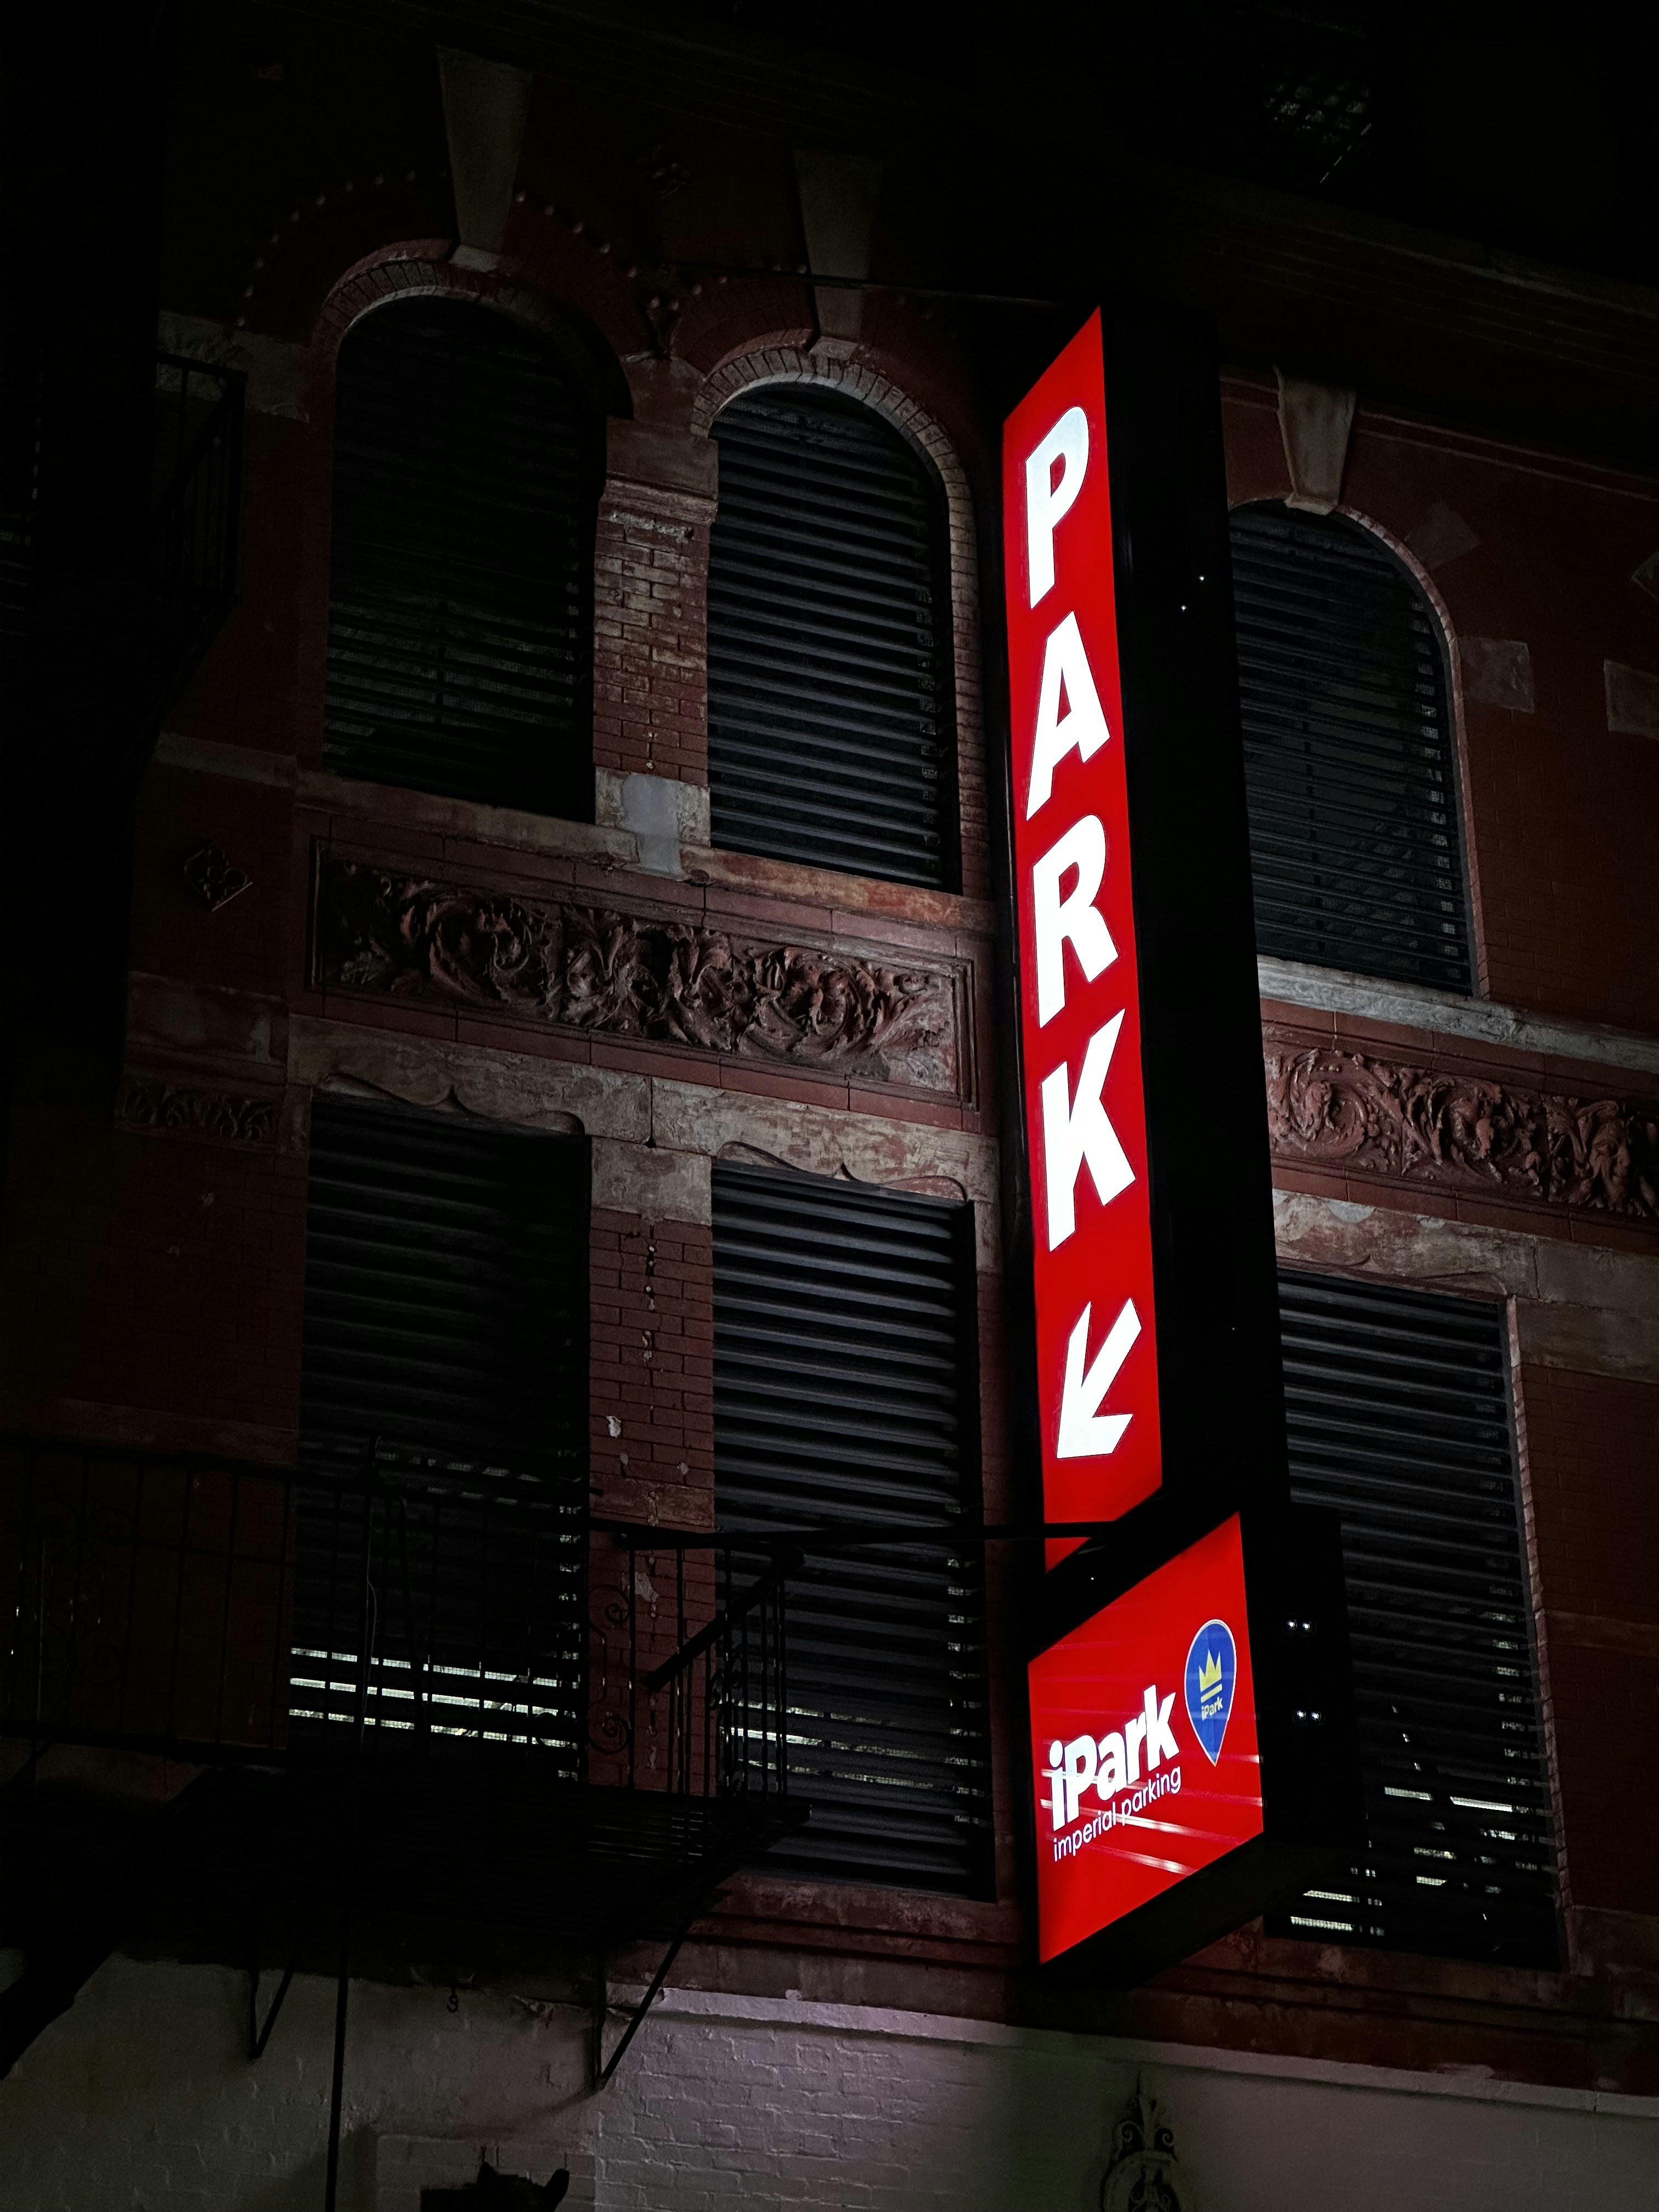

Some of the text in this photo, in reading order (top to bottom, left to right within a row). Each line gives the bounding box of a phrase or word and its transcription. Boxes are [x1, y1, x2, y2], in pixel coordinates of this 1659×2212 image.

[1024, 406, 1136, 1252] PARK
[1049, 1684, 1180, 1831] iPark
[1201, 1696, 1223, 1721] iPark
[1053, 1766, 1181, 1862] imperial parking
